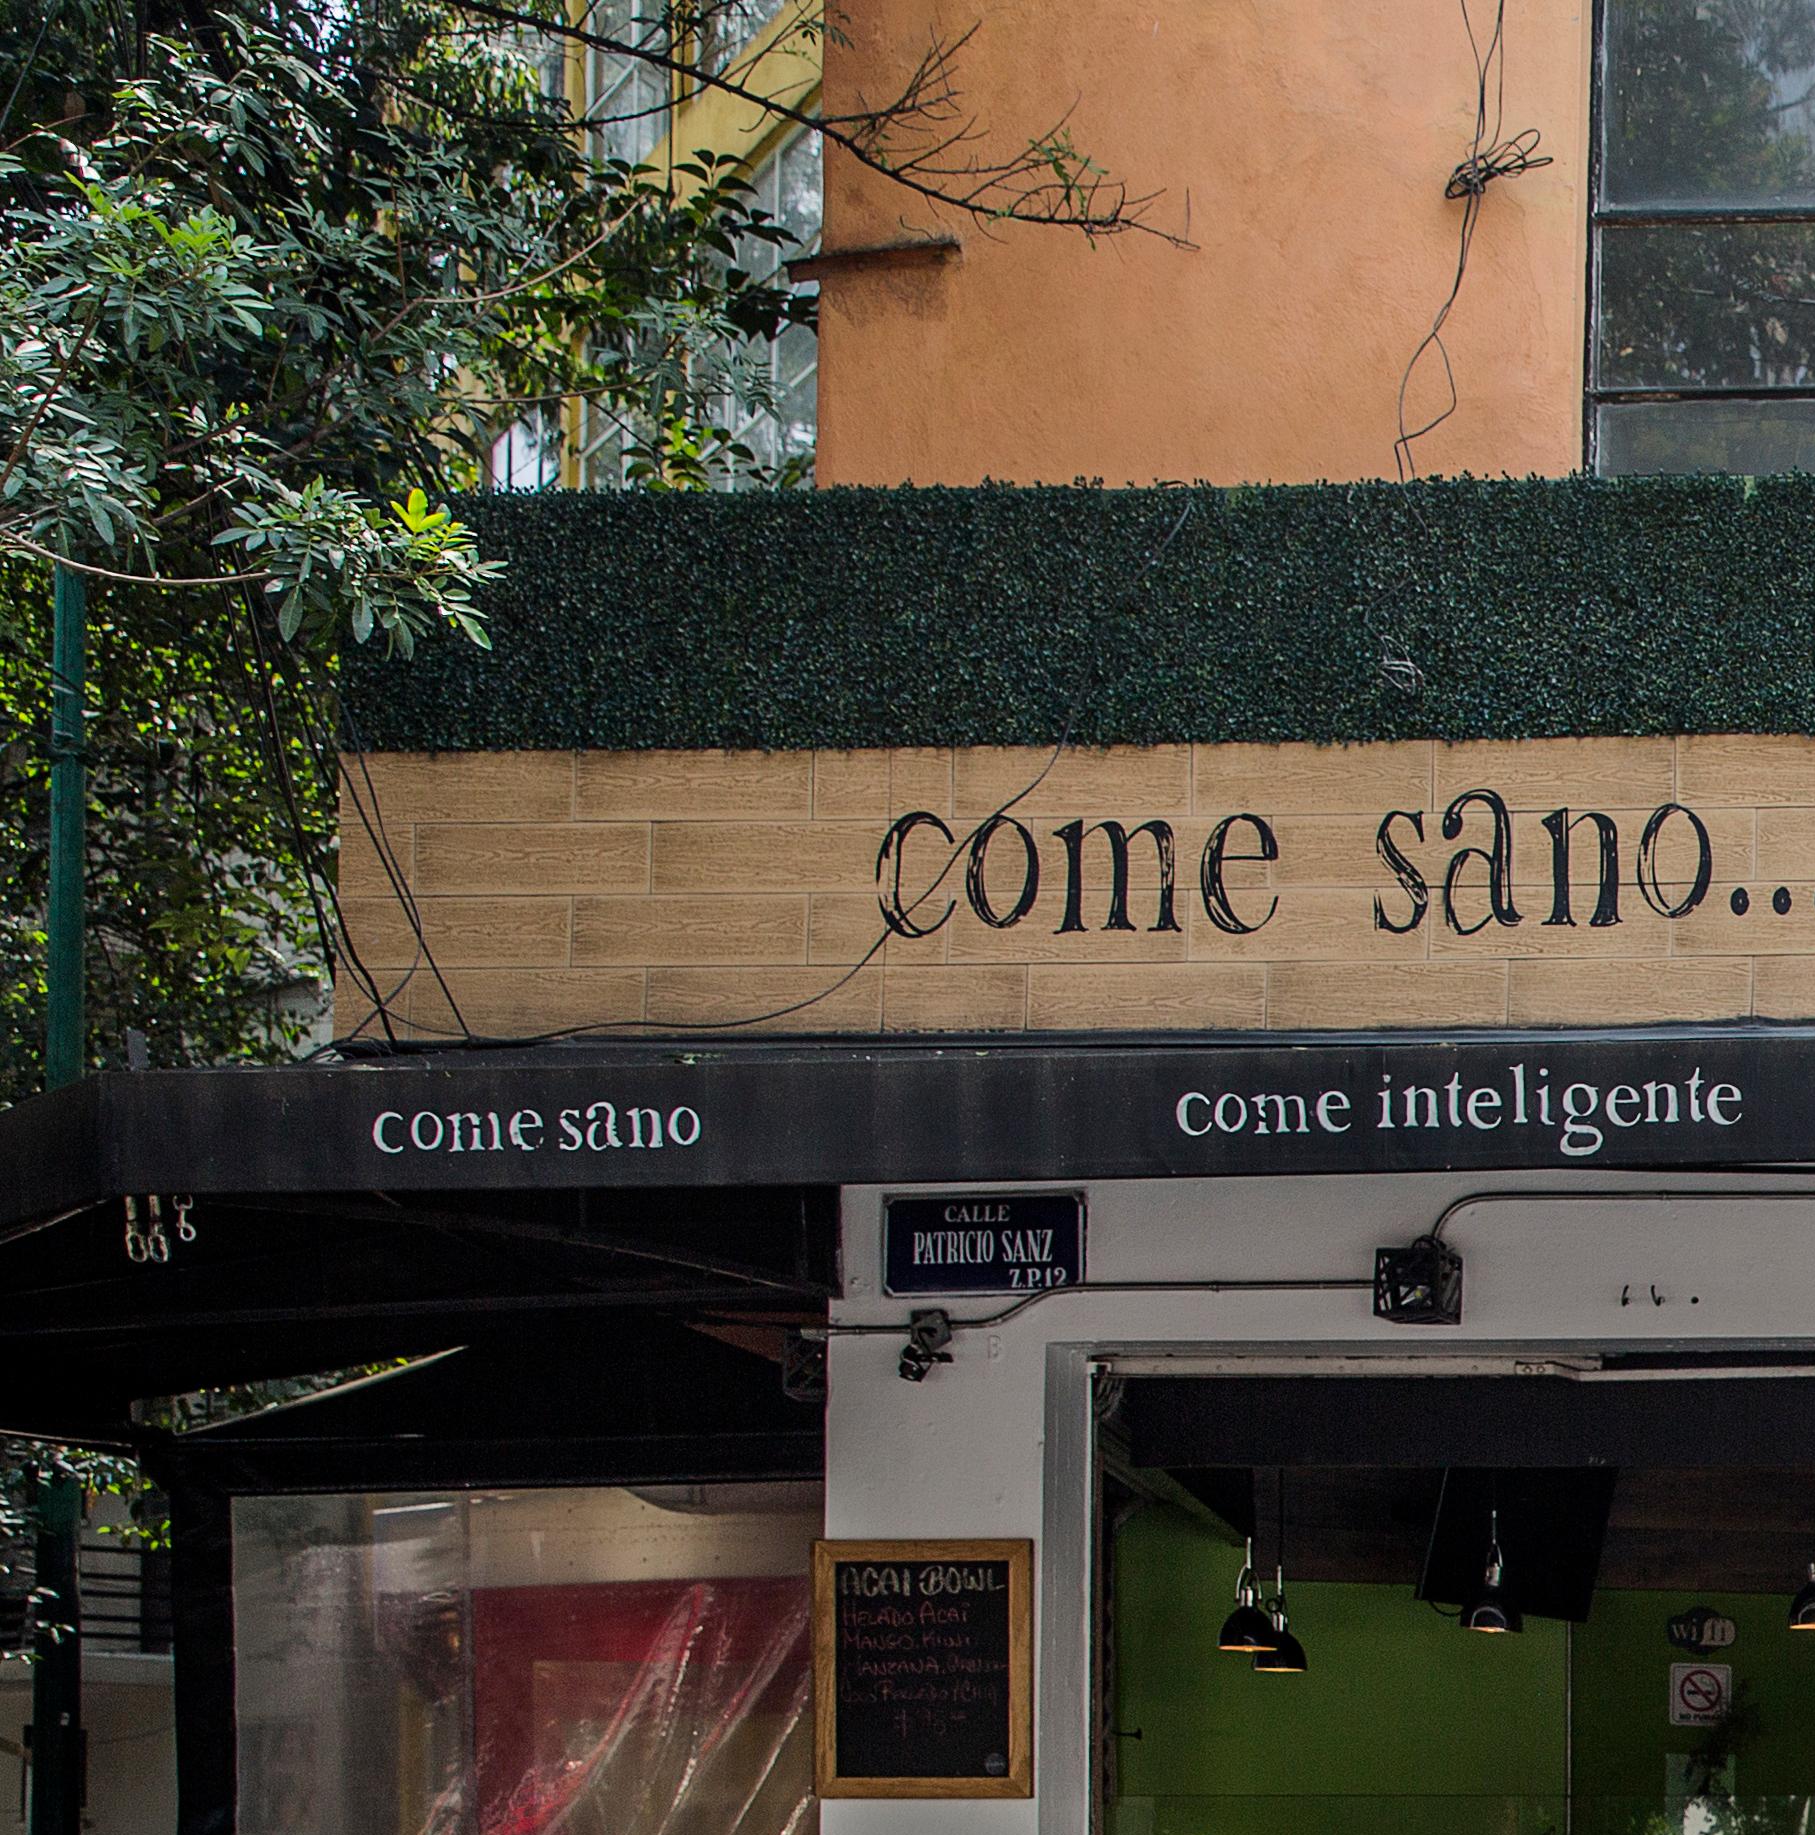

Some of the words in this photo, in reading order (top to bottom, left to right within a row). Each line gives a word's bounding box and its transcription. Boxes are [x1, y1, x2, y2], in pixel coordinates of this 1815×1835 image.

[872, 810, 1279, 938] come
[1176, 1090, 1351, 1137] come
[1377, 1063, 1743, 1156] inteligente
[372, 1109, 543, 1154] come
[559, 1101, 702, 1151] sano
[944, 1204, 1011, 1222] CALLE
[913, 1230, 995, 1264] PATRICIO
[1002, 1229, 1053, 1263] SANZ
[1009, 1267, 1067, 1289] Z.P.12
[841, 1566, 911, 1597] ACAI
[919, 1565, 1006, 1596] BOWL
